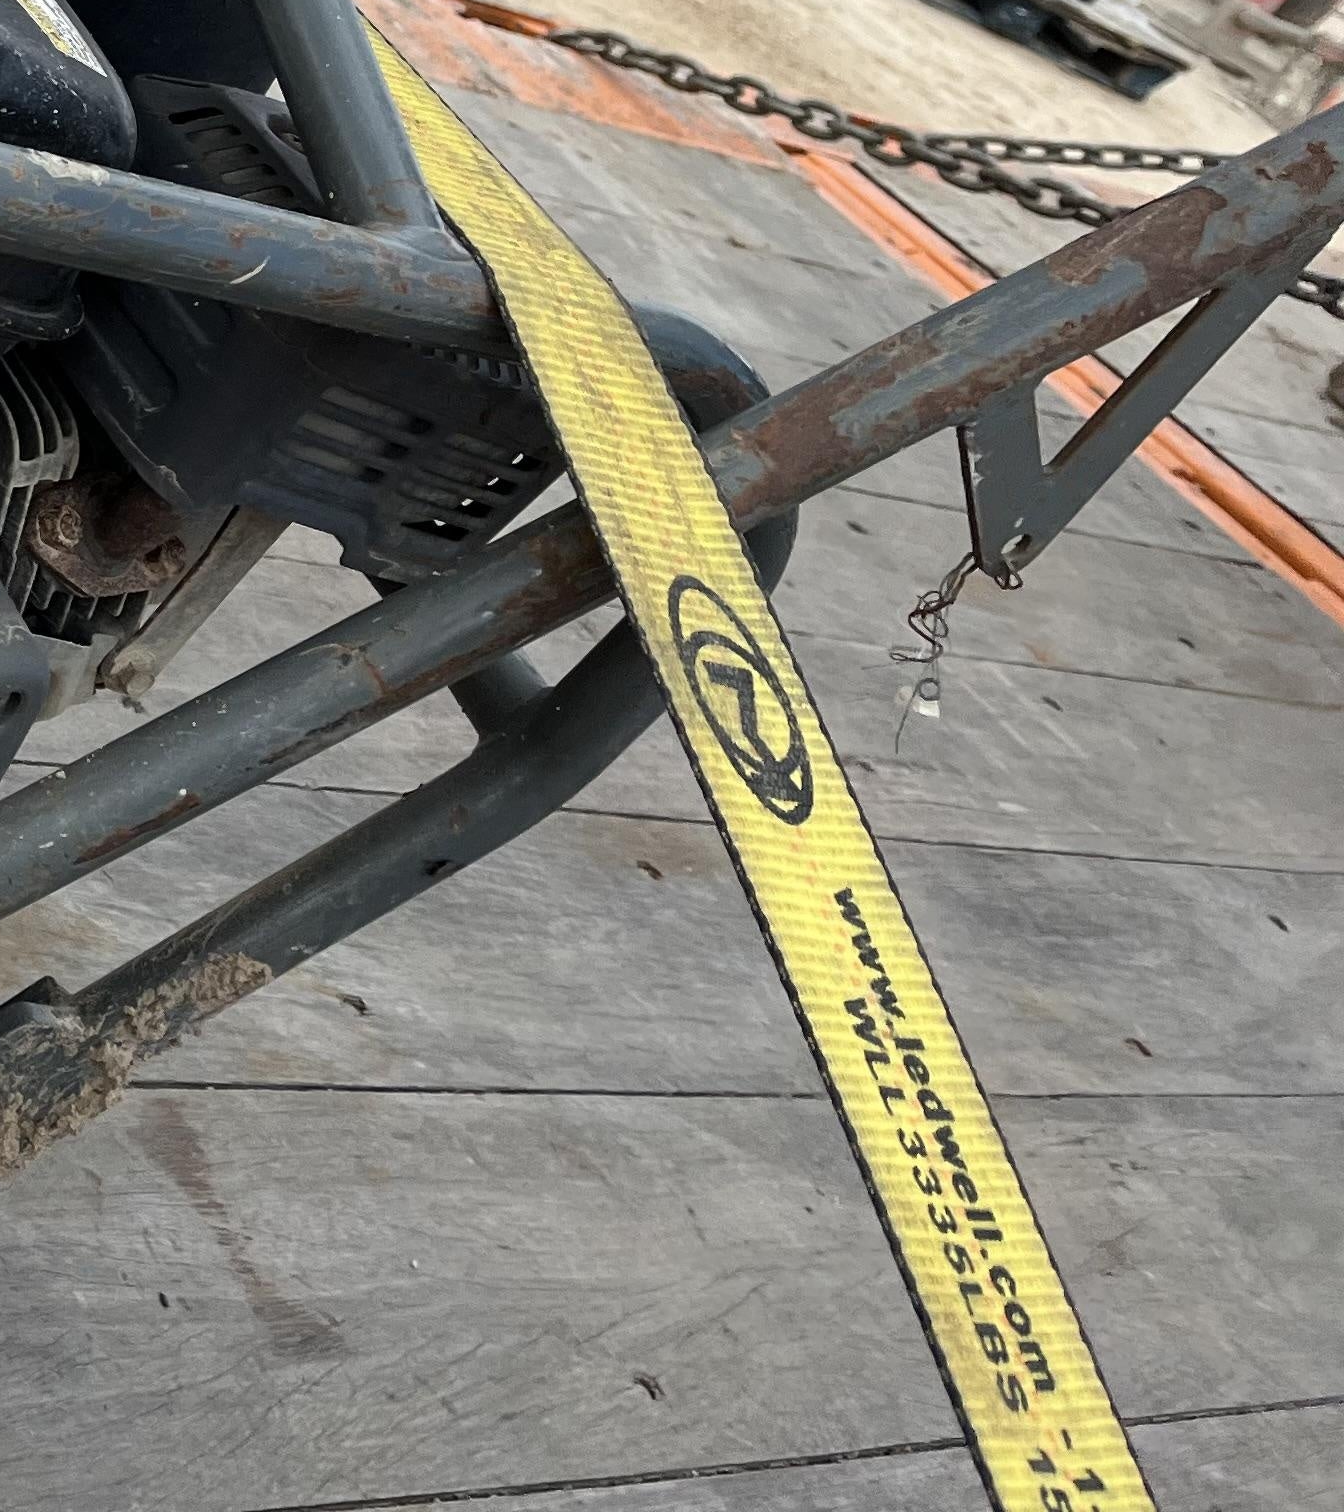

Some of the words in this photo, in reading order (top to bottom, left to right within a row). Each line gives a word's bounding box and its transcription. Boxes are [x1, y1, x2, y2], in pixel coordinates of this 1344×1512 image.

[834, 887, 1056, 1393] www.ledwell.com
[843, 997, 906, 1116] WLL
[896, 1127, 1029, 1414] 3335LBS
